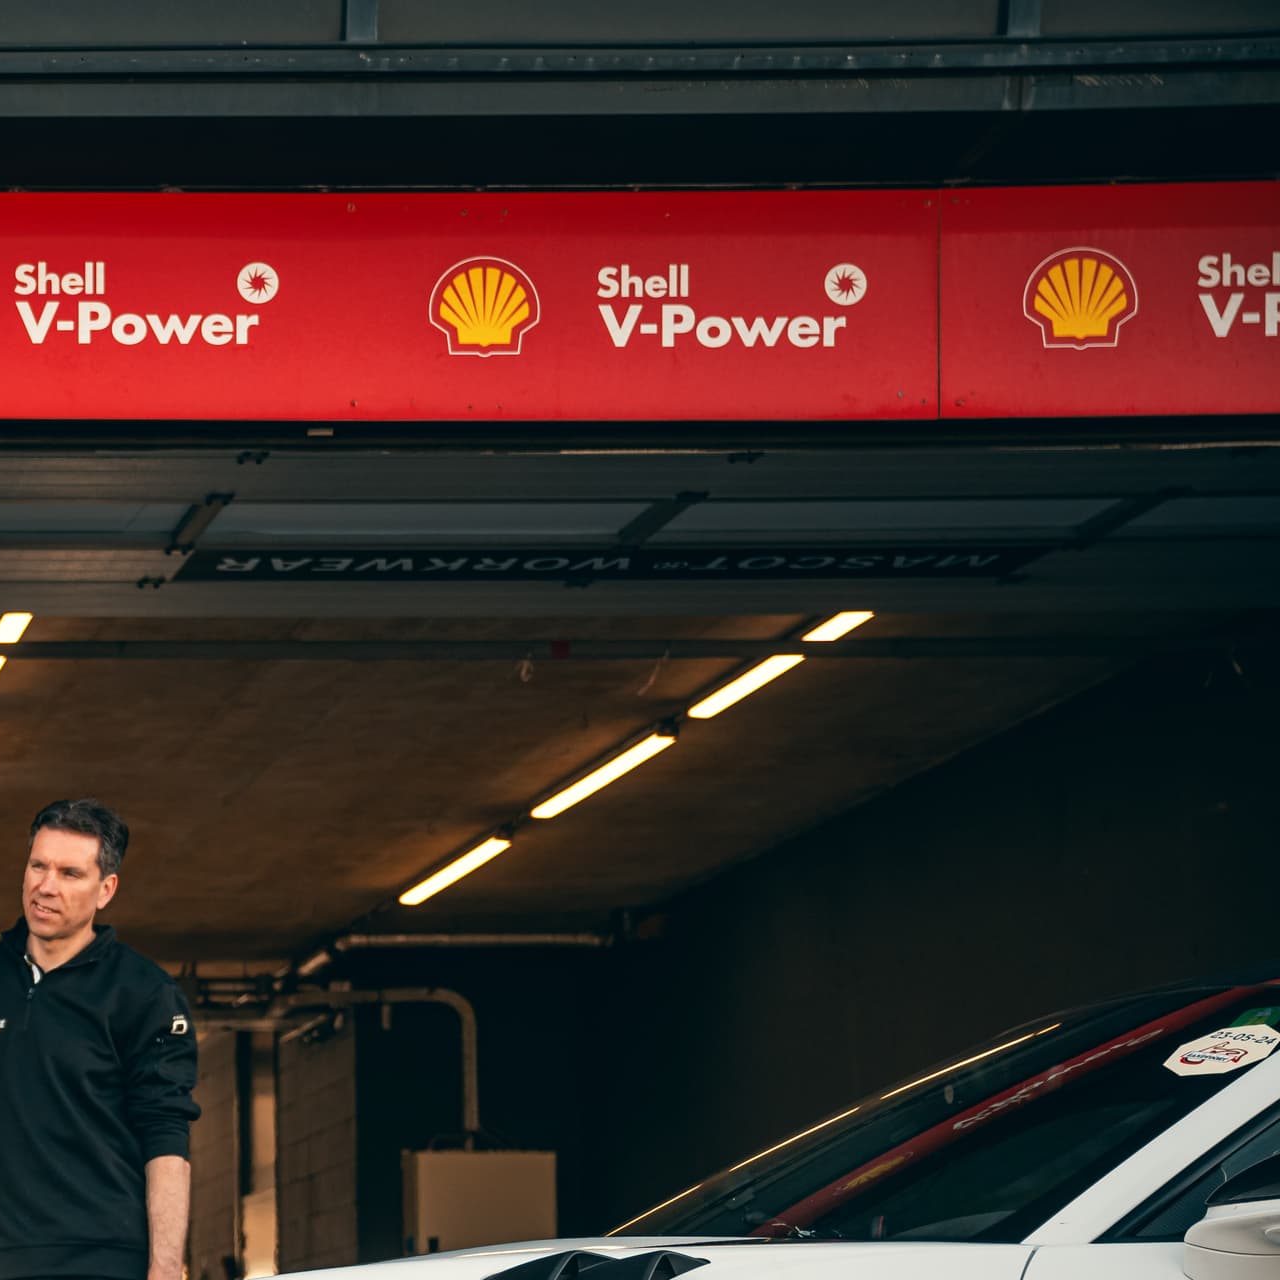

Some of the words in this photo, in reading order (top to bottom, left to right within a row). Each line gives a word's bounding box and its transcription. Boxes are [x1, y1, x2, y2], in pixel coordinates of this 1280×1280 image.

[14, 262, 105, 295] Shell
[597, 264, 689, 298] Shell
[15, 303, 259, 346] V-Power
[598, 304, 847, 348] V-Power
[215, 556, 632, 571] WORKWEAR
